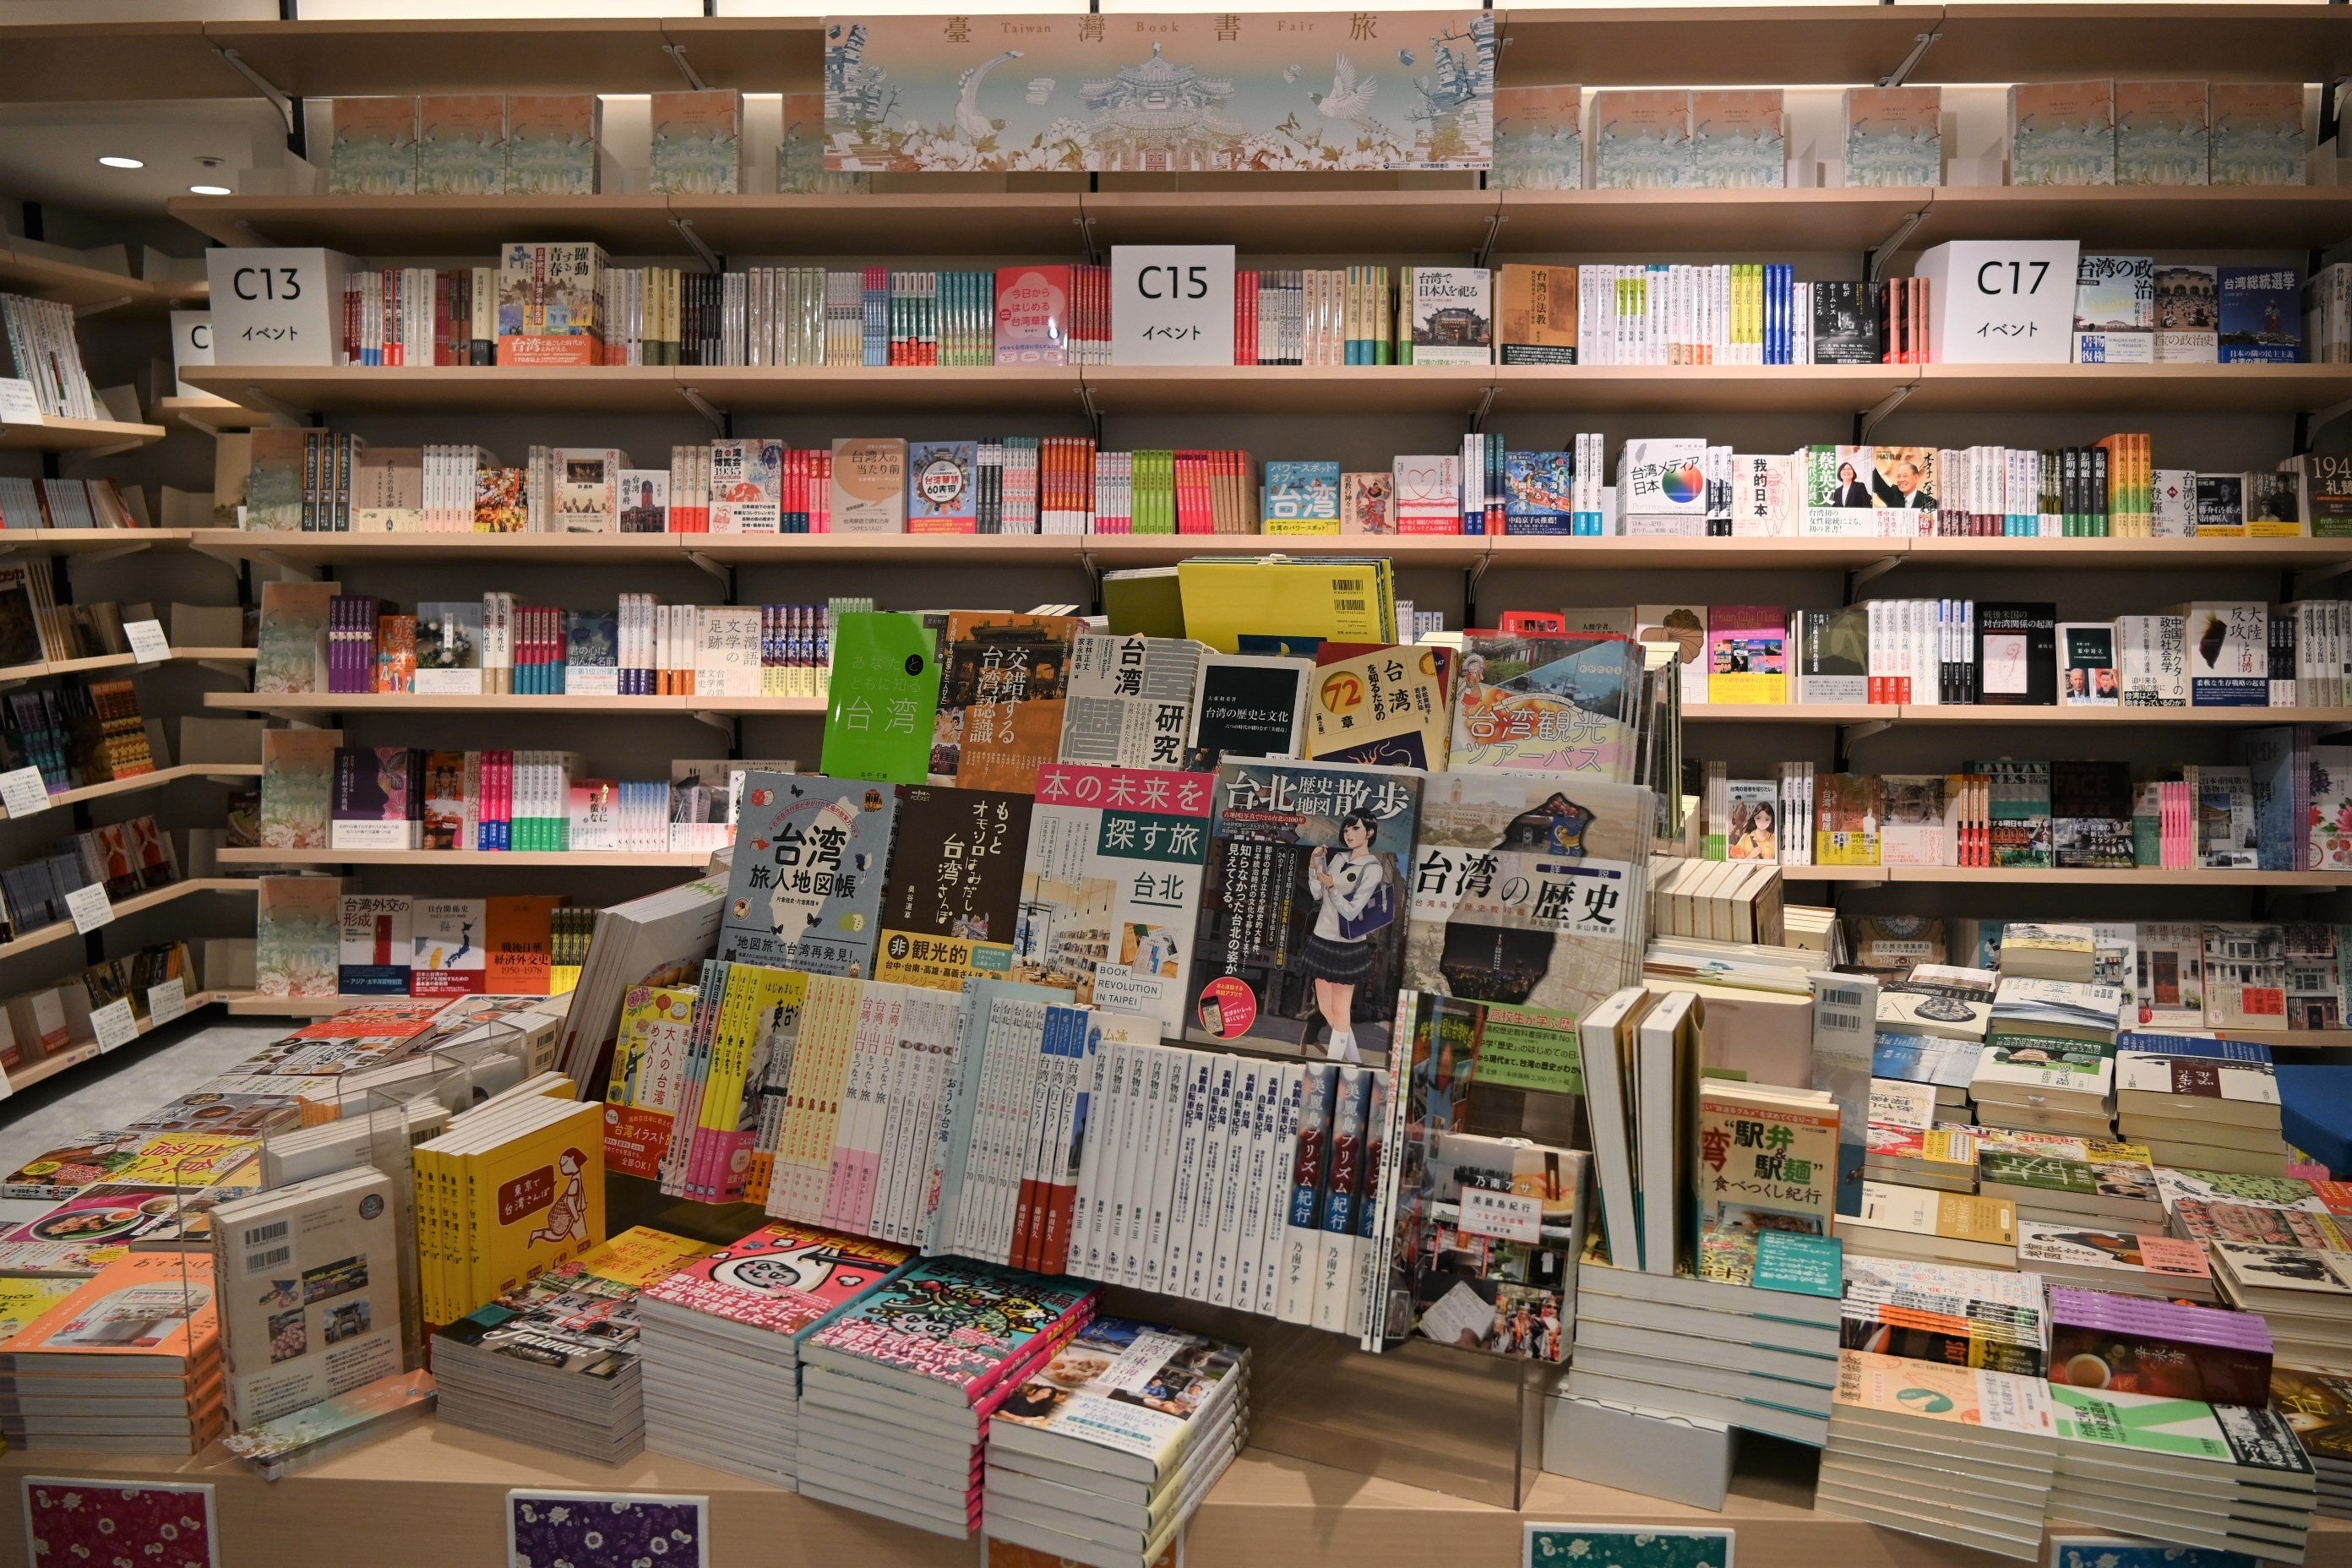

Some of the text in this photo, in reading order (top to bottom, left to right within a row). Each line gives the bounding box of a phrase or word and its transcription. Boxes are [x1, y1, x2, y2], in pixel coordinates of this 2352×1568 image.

[945, 13, 1377, 43] 臺 Taiwan 灣 Book 書 Fair 旅
[549, 248, 563, 276] 青春
[563, 253, 572, 271] する
[574, 248, 589, 275] 躍動
[233, 268, 301, 301] C13
[1138, 266, 1208, 299] C15
[1419, 273, 1452, 284] 台湾で
[1419, 286, 1478, 297] 日本人を祀る
[1843, 284, 1849, 297] 私が
[1978, 262, 2050, 295] C17
[2135, 280, 2153, 300] 治
[2224, 272, 2295, 290] 台湾総統選挙
[1012, 302, 1050, 311] はじめる
[1013, 289, 1050, 299] 今日から
[1536, 271, 1547, 324] 台湾の法教
[191, 325, 212, 349] C
[242, 325, 298, 342] イベント
[512, 338, 541, 351] 台湾
[1142, 325, 1200, 341] イベント
[1978, 322, 2038, 338] イベント
[2082, 336, 2104, 347] 書物
[2082, 350, 2104, 362] 復権
[2230, 350, 2294, 358] 日本の隣の民主主義
[715, 458, 742, 466] 博覧会
[852, 451, 898, 463] 台湾人の
[857, 466, 900, 475] 当たり前
[2066, 453, 2076, 478] 彭明敏
[632, 475, 640, 493] 台湾
[925, 476, 960, 485] 台湾華語
[928, 485, 956, 494] 60表現
[1534, 482, 1542, 500] 渡る
[1634, 480, 1660, 495] 日本
[1754, 458, 1767, 517] 我的日本
[1808, 452, 1816, 506] 新時代の台湾へ
[1817, 452, 1836, 505] 蔡英文
[1920, 452, 1936, 514] 李登輝
[2150, 471, 2162, 515] 李登輝
[1271, 484, 1337, 518] 台湾
[1549, 482, 1558, 510] 海峡を
[2183, 472, 2196, 537] 台湾の主張
[1809, 517, 1861, 525] 女性総統による、
[1818, 614, 1824, 624] 台湾
[1983, 610, 2028, 619] 戦後米国の
[1983, 620, 2054, 629] 対台湾関係の起源
[2230, 607, 2246, 639] 反攻
[2247, 607, 2262, 640] 大陸
[708, 619, 723, 649] 足跡
[726, 619, 740, 662] 文学の
[743, 619, 759, 666] 台湾語
[2160, 617, 2172, 672] 政治社会学
[2304, 610, 2313, 663] 台湾をめぐる安全保障
[569, 646, 606, 656] 君の心に
[569, 656, 617, 666] 刻んだ名前
[1075, 638, 1085, 671] 家永真幸
[1082, 638, 1093, 671] 若林正丈
[2173, 617, 2184, 694] 中国ファクターの
[1114, 638, 1146, 696] 台湾
[850, 678, 921, 693] ともに知る
[969, 645, 995, 744] 台湾認識
[999, 645, 1029, 743] 交錯する
[1324, 679, 1362, 712] 72
[1368, 664, 1386, 721] を知るための
[1384, 660, 1411, 714] 台湾
[847, 697, 917, 733] 台湾
[1206, 708, 1288, 723] 台湾の歴史と文化
[1341, 716, 1354, 729] 章
[1467, 706, 1606, 744] 台湾観光
[1153, 704, 1184, 763] 研究
[1467, 742, 1602, 772] ツアーバス
[1042, 770, 1204, 810] 本の未来を
[1226, 770, 1411, 819] 台北 歴史 散歩
[1295, 797, 1330, 816] 地図
[988, 802, 1008, 855] もっと
[1106, 817, 1200, 855] 探す旅
[773, 822, 847, 872] 台湾
[962, 801, 988, 911] オモシロはみだし
[749, 864, 857, 899] 旅人地図帳
[936, 833, 965, 923] 台湾さんぽ
[1134, 872, 1184, 900] 台北
[1222, 843, 1239, 908] 見えてくる。
[1417, 850, 1620, 925] 台湾の歴史
[345, 898, 409, 912] 台湾外交の
[428, 905, 468, 913] 日台関係史
[904, 885, 914, 919] 奥谷道草
[1225, 843, 1252, 975] 知らなかった台北の姿が
[343, 913, 372, 927] 形成
[494, 954, 548, 964] 経済外交史
[501, 942, 542, 952] 戦後日華
[890, 937, 968, 965] 非 観光的
[501, 966, 542, 975] 1950-1978
[1100, 966, 1128, 977] BOOK
[765, 984, 803, 995] はじめまして、
[1097, 994, 1137, 1005] IN TAIPEI
[1098, 980, 1157, 994] REVOLUTION
[991, 1003, 1000, 1026] 台北
[646, 1025, 660, 1069] めぐり
[845, 996, 874, 1099] 台湾と山口をつなぐ旅
[653, 1026, 676, 1105] 大人の台湾
[1092, 1052, 1107, 1092] 台湾物語
[1033, 1057, 1050, 1130] 台湾へ行こう!
[1184, 1083, 1196, 1129] 自転車紀行
[1194, 1066, 1208, 1121] 美麗島・台湾
[938, 1078, 958, 1142] おうち台湾
[622, 1157, 652, 1171] 全部OK!
[1296, 1077, 1326, 1225] 美麗島プリズム紀行
[1775, 1148, 1786, 1160] &
[513, 1179, 541, 1198] 東京で
[1475, 1175, 1532, 1193] 乃南アサ
[1713, 1175, 1822, 1204] 食べつくし紀行
[504, 1187, 551, 1217] 台湾さんぽ
[1473, 1195, 1533, 1213] 美麗島紀行
[764, 1224, 911, 1266] 台湾・台北編
[1289, 1241, 1303, 1286] 乃南アサ
[670, 1273, 824, 1316] 願いが叶うランタンに
[840, 1317, 1000, 1367] マンゴー?タピオカ?
[812, 1333, 977, 1386] まずはバナナでしょ!
